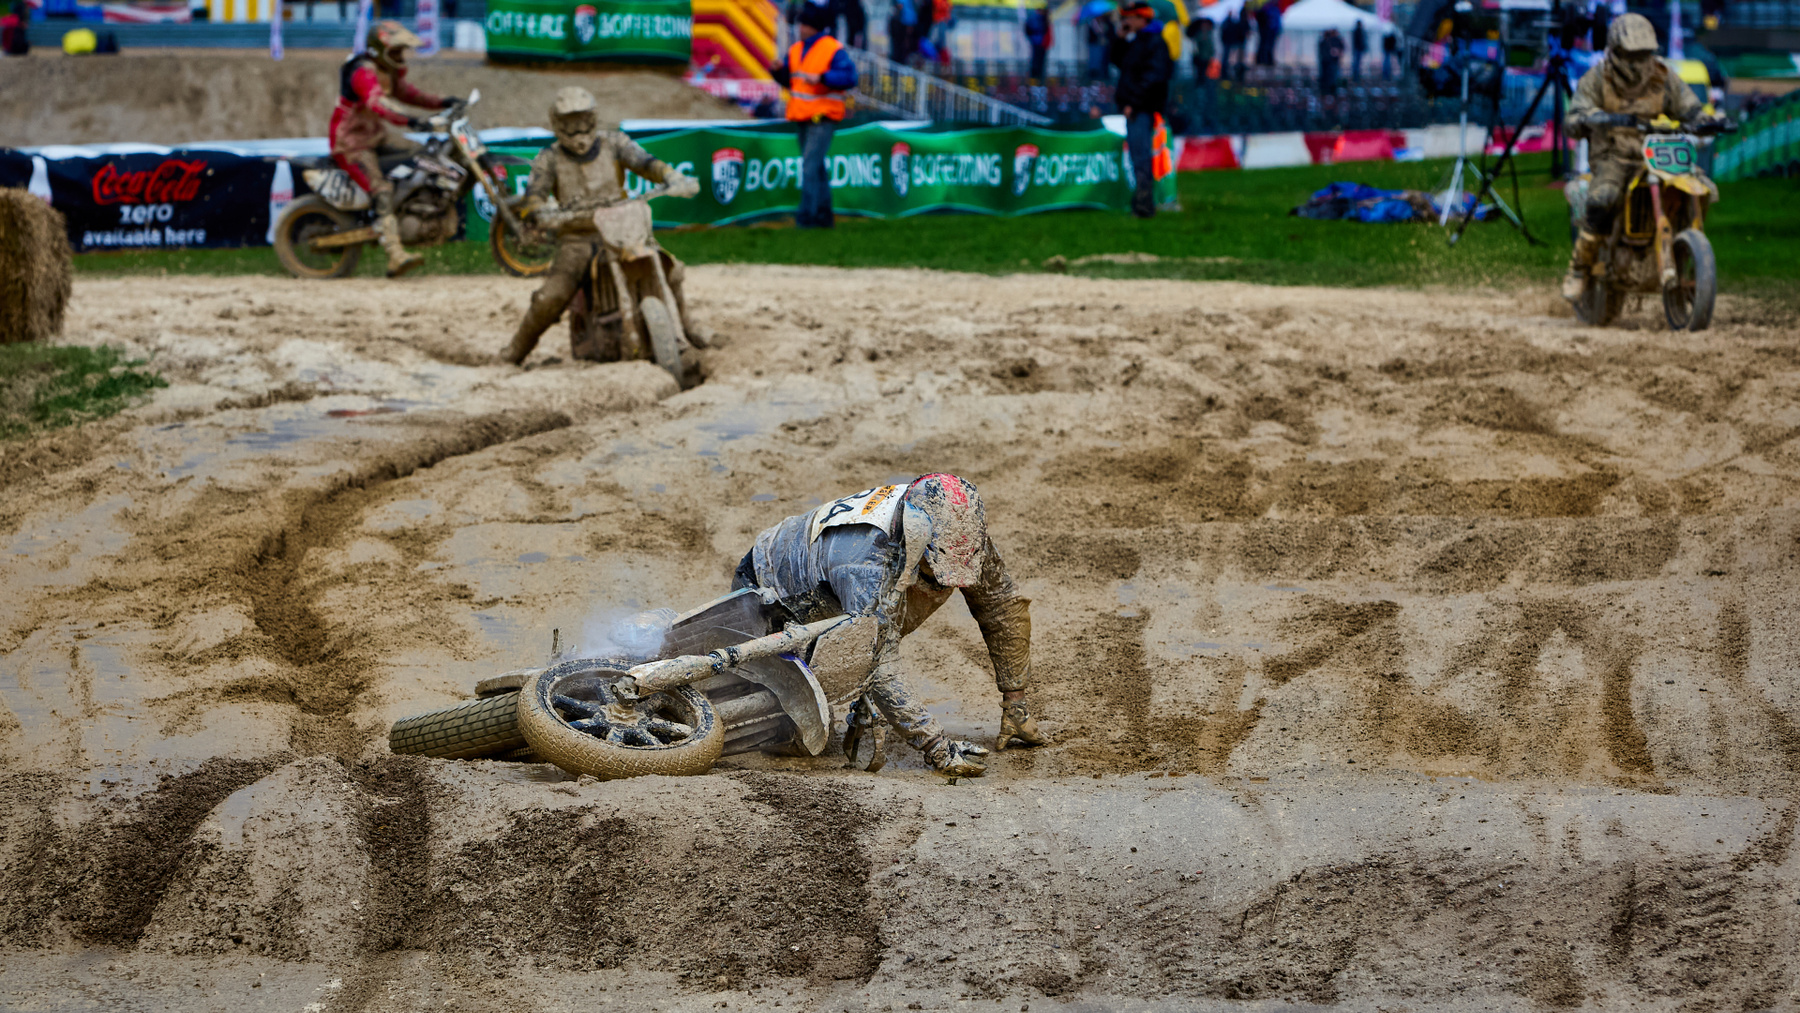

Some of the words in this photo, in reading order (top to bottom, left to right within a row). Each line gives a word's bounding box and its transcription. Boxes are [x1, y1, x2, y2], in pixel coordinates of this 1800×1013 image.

[1655, 146, 1691, 166] 50
[119, 203, 173, 224] zero
[83, 228, 161, 246] available
[164, 226, 206, 244] here
